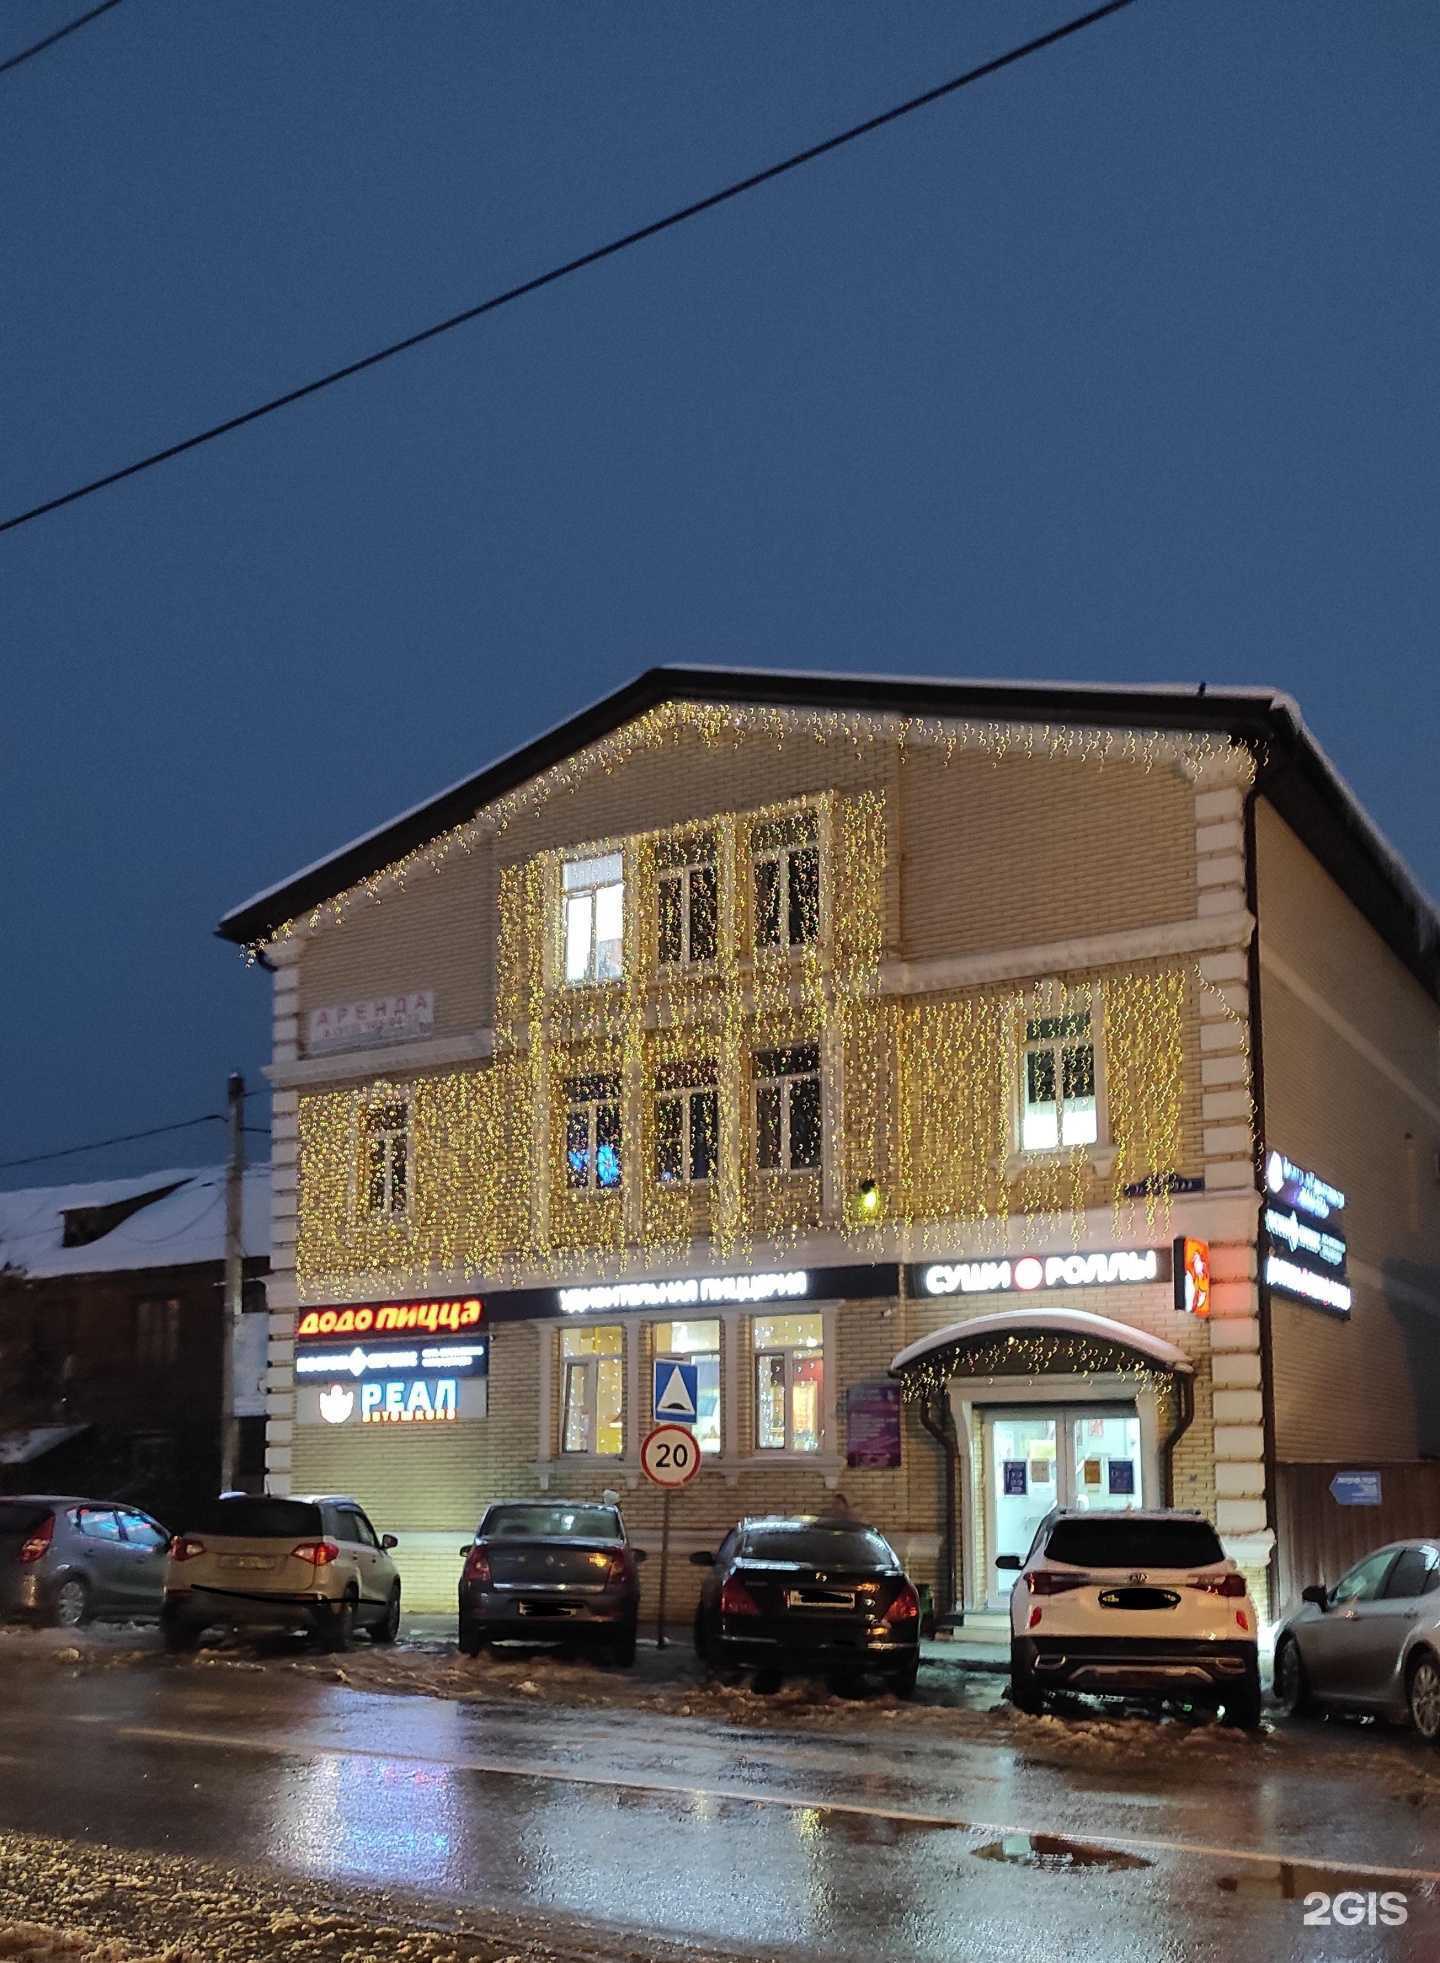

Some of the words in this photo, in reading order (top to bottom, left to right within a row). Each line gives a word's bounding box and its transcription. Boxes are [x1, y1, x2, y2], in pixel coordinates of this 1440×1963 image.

[926, 1260, 1012, 1294] СУШИ
[1045, 1250, 1157, 1287] РОЛЛЫ
[361, 1379, 457, 1413] РЕАЛ
[656, 1443, 688, 1468] 20
